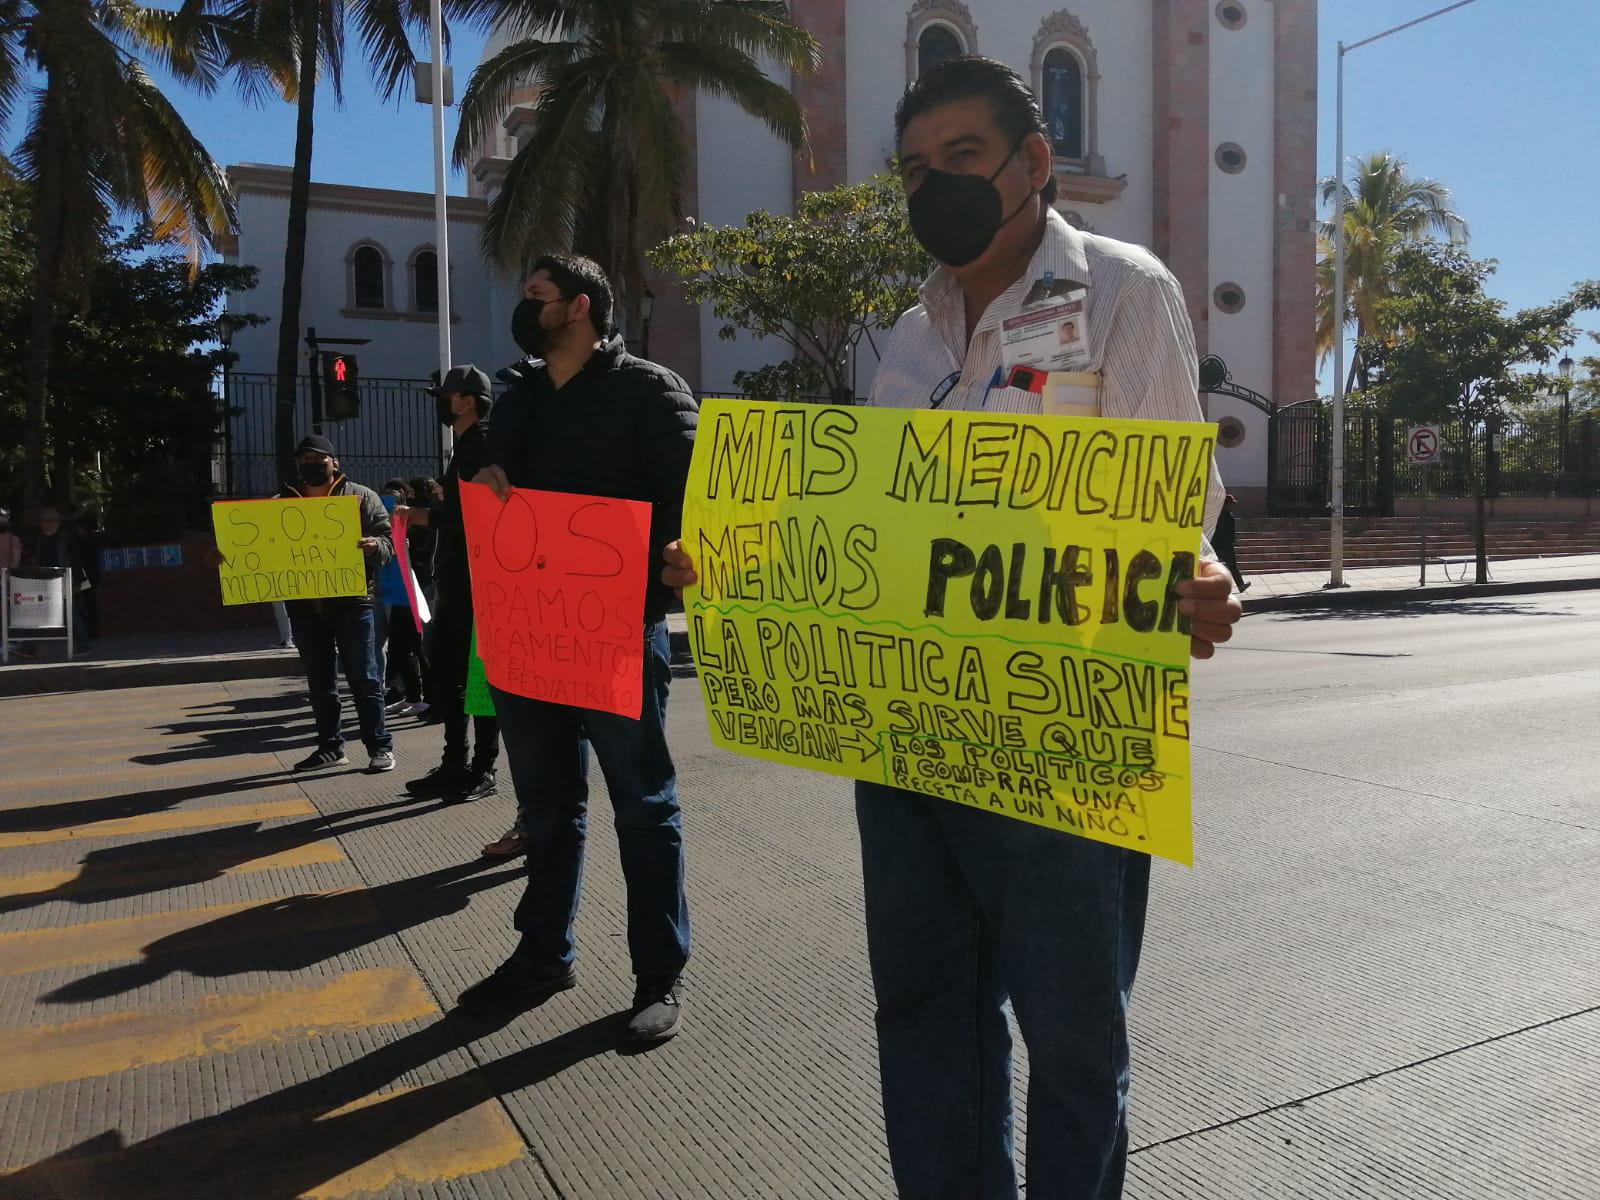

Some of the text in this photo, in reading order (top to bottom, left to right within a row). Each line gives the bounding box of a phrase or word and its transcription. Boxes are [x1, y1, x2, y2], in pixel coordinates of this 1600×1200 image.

[707, 408, 1214, 528] MAS MEDICINA
[221, 563, 366, 603] MEDICAMENTOS
[290, 544, 338, 567] HAY
[699, 514, 880, 610] MENOS
[693, 615, 1190, 741] LA POLITICA SIRVE
[704, 672, 1155, 770] PERO MAS SIRVE QUE
[711, 709, 844, 764] VENGAN
[889, 734, 1165, 792] LOS POLITICOS
[891, 755, 1136, 814] A COMPRAR UNA
[896, 773, 979, 805] RECETA
[989, 791, 1005, 809] A
[1013, 797, 1046, 818] UN
